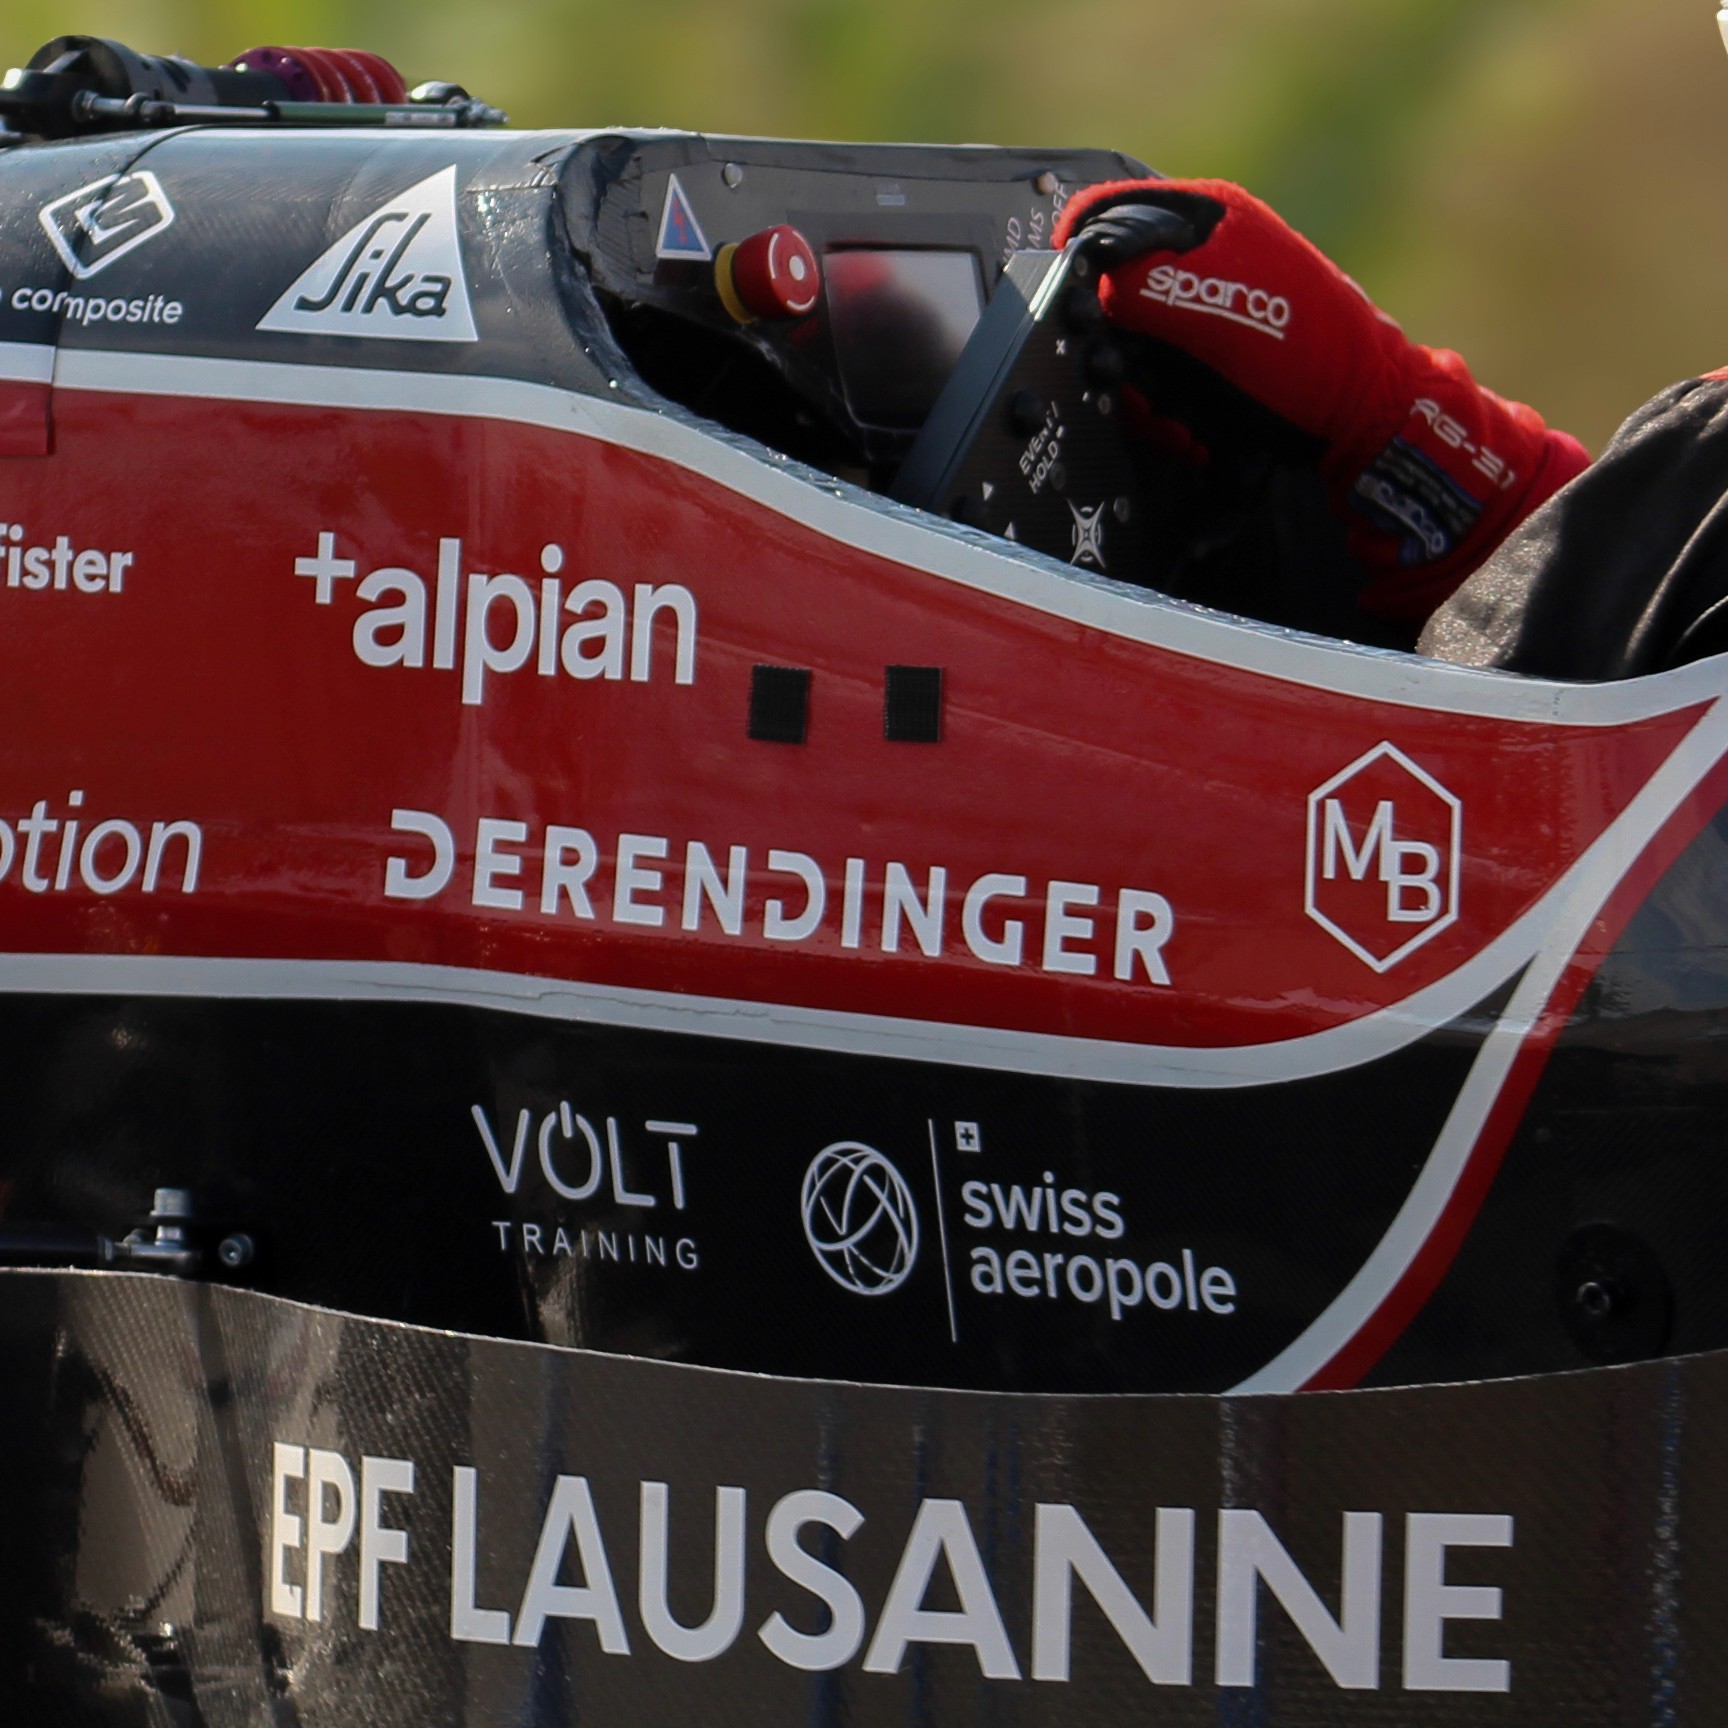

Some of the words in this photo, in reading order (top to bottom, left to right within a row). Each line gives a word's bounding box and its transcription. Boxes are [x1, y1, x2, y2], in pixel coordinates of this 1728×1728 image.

[293, 210, 453, 319] Sika
[1144, 264, 1291, 332] sparco
[11, 287, 183, 327] composite
[384, 808, 1174, 986] DERENDINGER
[470, 1100, 699, 1210] VOLT
[961, 1170, 1125, 1240] swiss
[491, 1221, 699, 1270] TRAINING
[970, 1246, 1237, 1322] aeropole
[271, 1441, 415, 1631] EPF
[450, 1464, 1513, 1693] LAUSANNE
